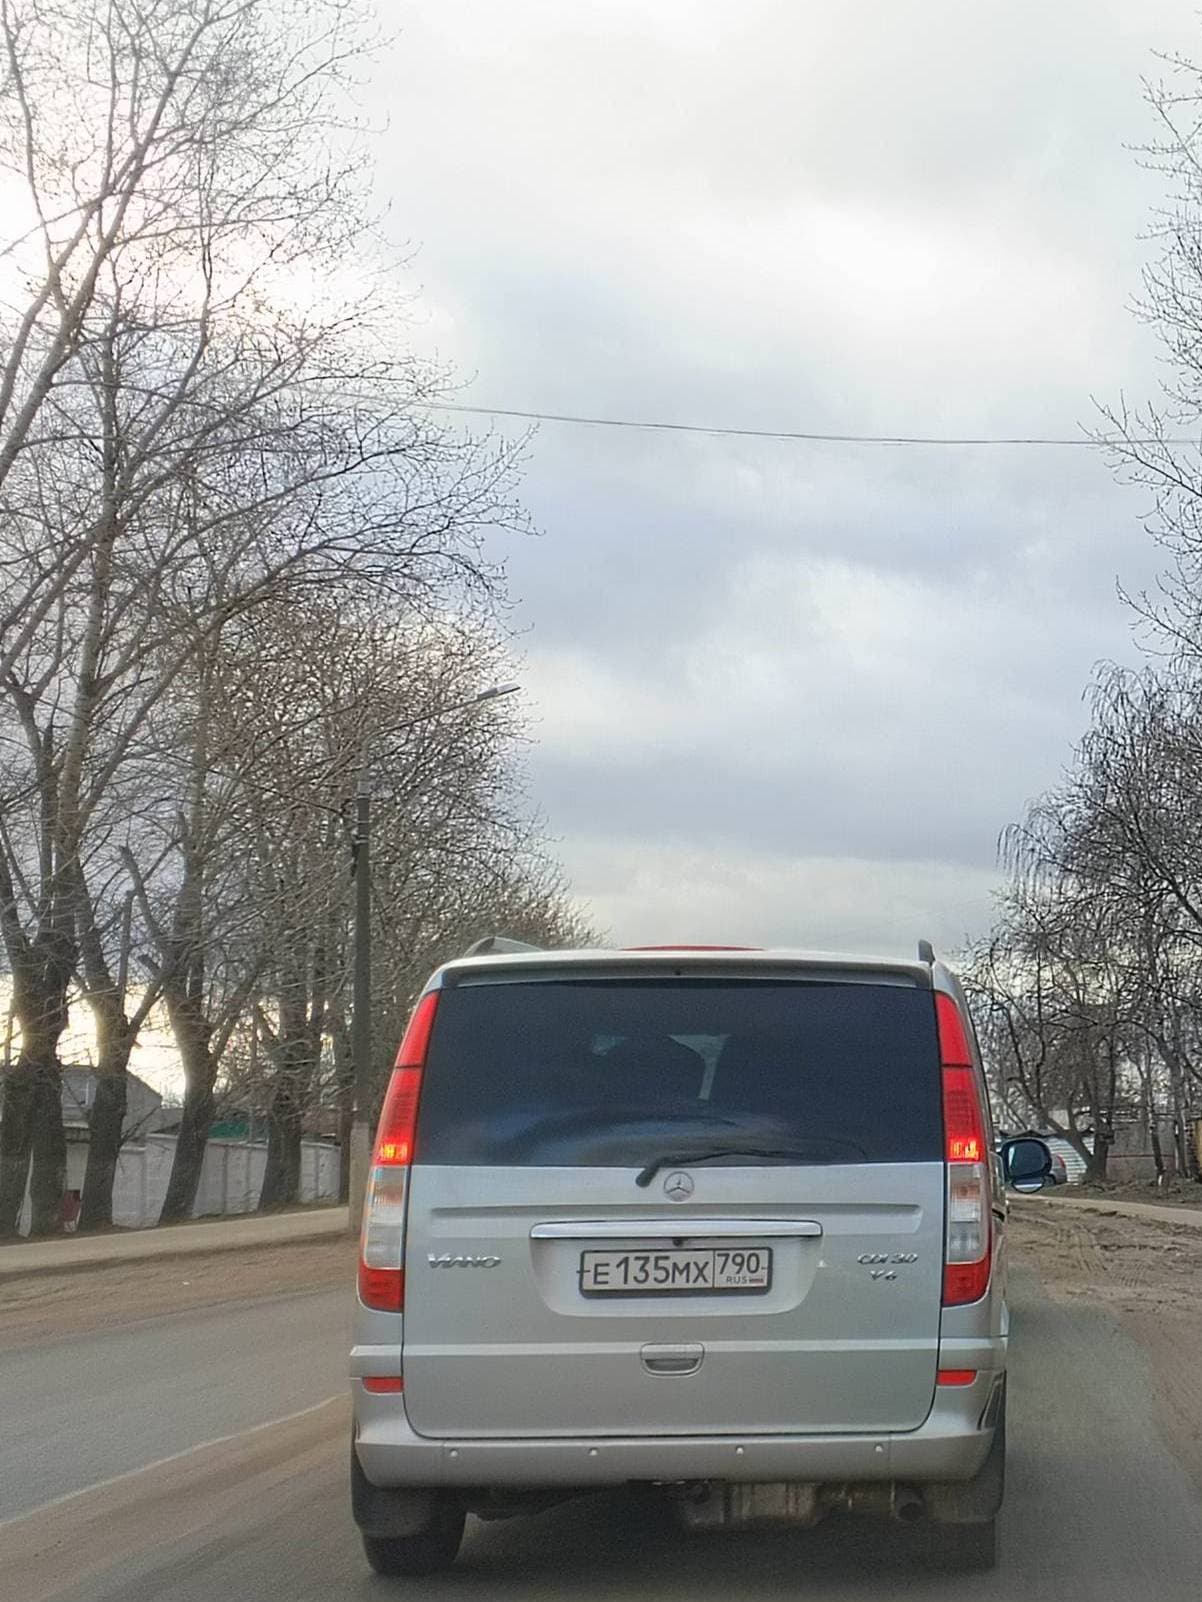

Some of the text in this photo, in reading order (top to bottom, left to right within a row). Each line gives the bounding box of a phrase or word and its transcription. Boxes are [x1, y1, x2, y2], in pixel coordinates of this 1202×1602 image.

[427, 1252, 502, 1269] VIANO
[593, 1253, 760, 1285] Е135МХ 790
